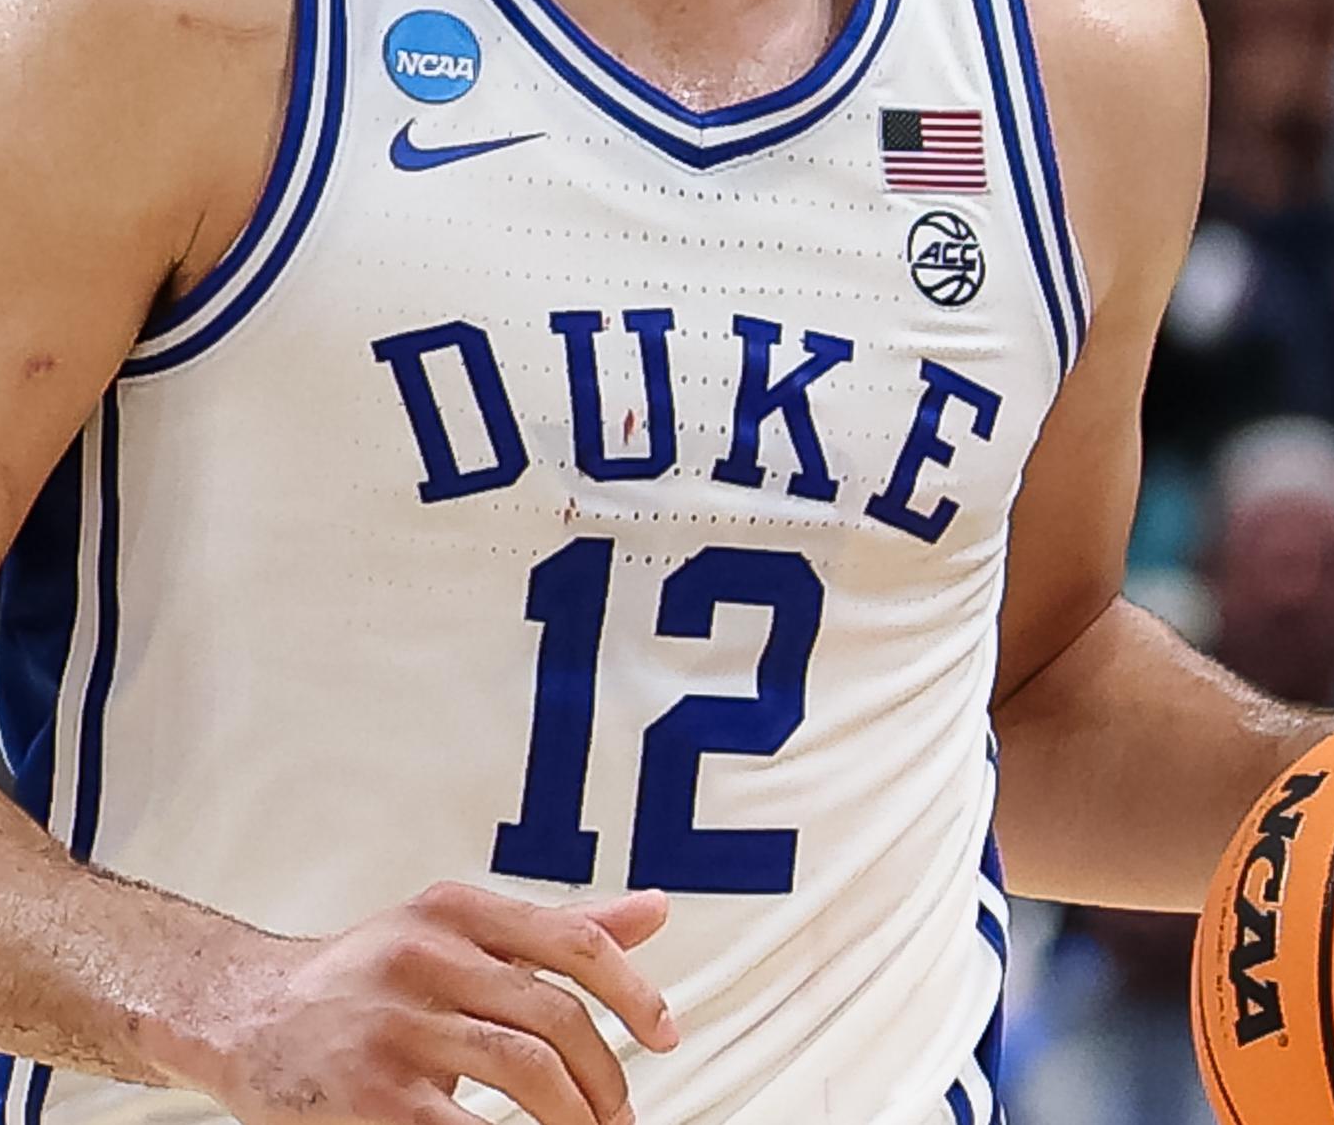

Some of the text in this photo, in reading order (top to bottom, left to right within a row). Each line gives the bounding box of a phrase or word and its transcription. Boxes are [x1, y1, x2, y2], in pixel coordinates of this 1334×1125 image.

[396, 49, 475, 82] NCAA
[917, 241, 979, 271] ACC
[371, 308, 1002, 544] DUKE
[489, 536, 826, 895] 12
